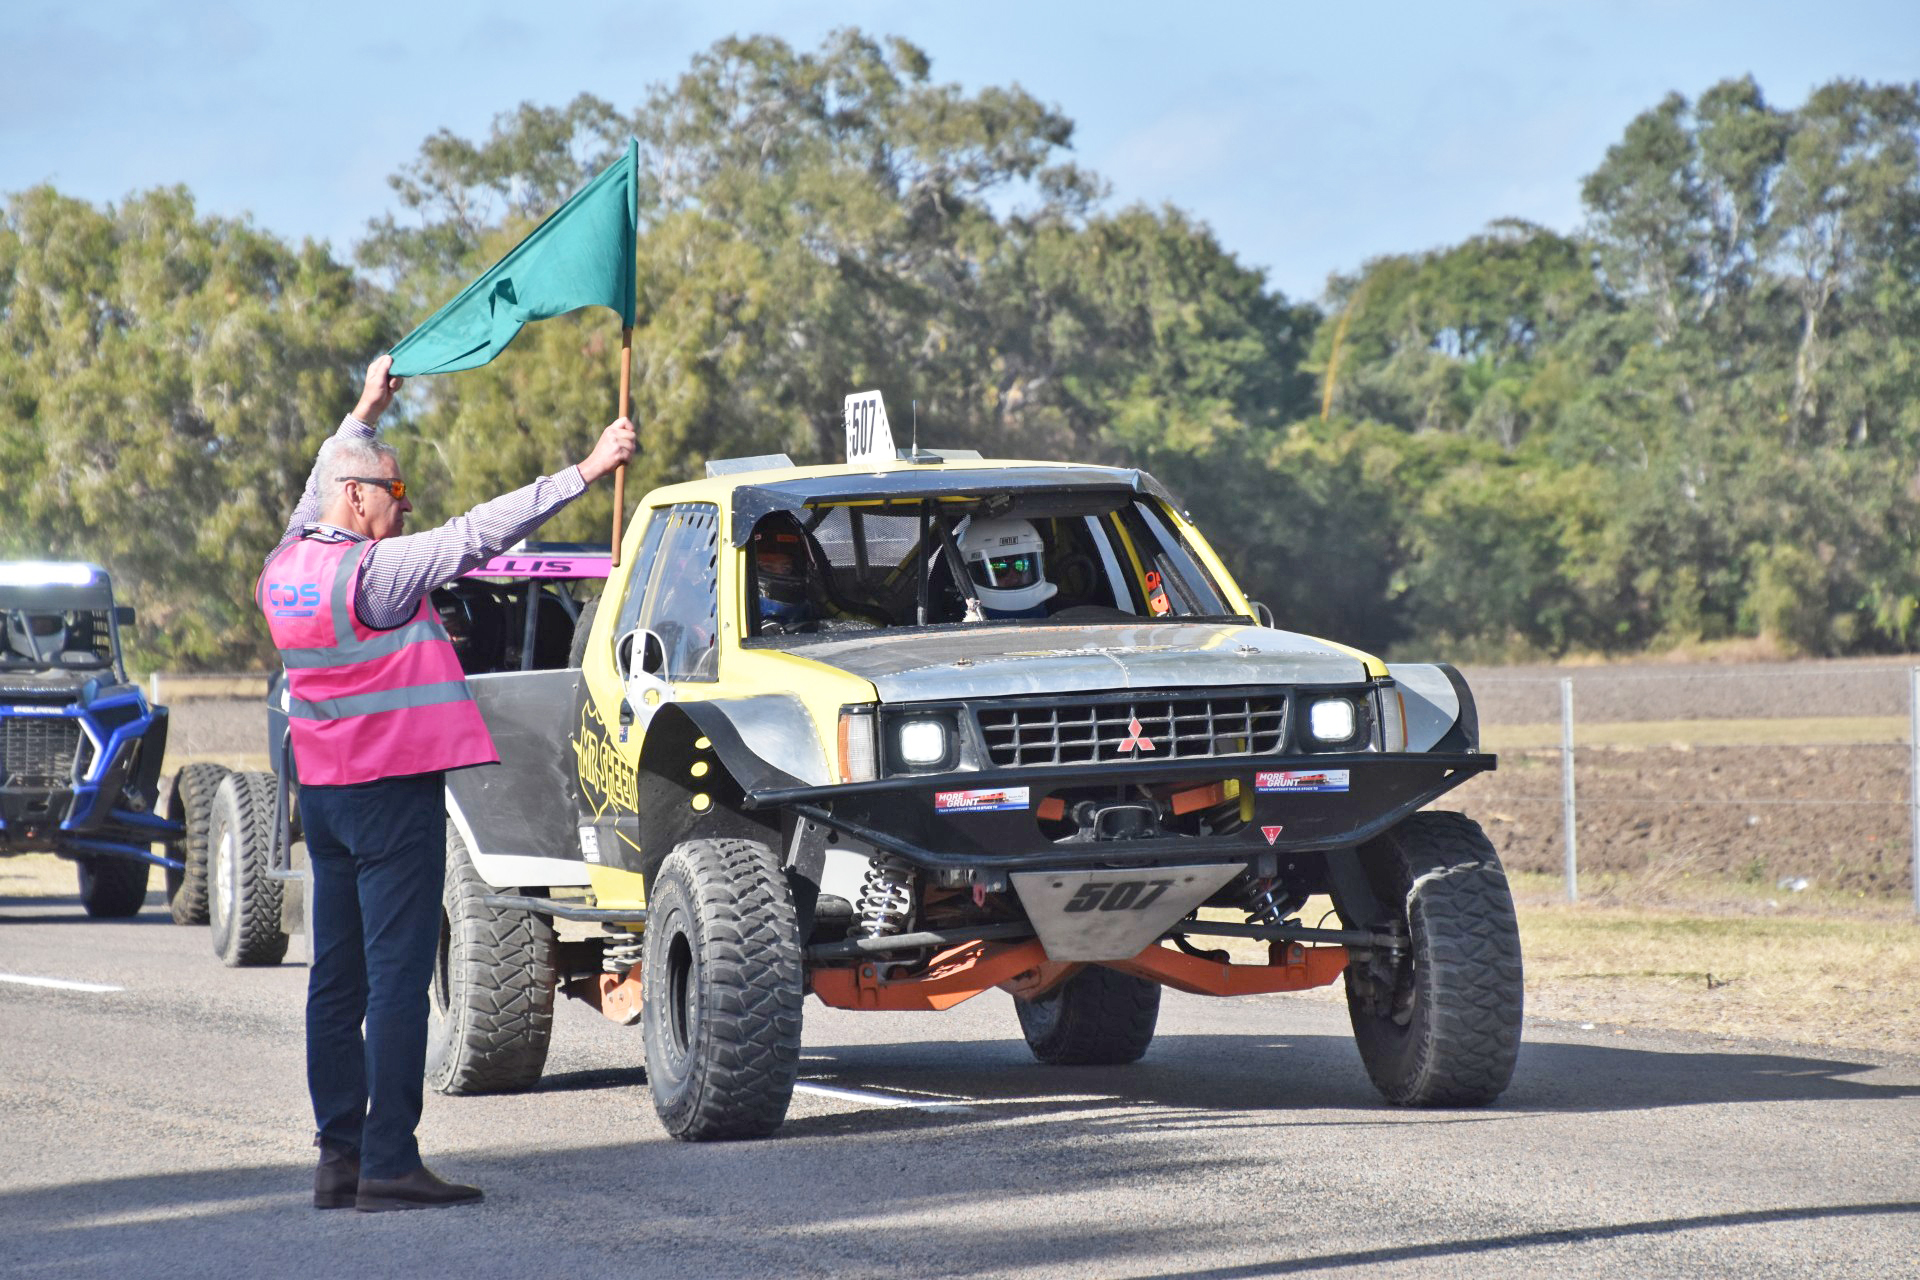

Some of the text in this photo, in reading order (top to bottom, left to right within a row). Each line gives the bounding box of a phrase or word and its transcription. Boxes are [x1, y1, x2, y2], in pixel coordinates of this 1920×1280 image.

[852, 399, 876, 456] 507
[476, 560, 573, 572] LLIS
[269, 583, 320, 606] CDS
[1259, 773, 1285, 781] MORE
[1267, 778, 1301, 787] GRUNT
[939, 792, 965, 802] MORE
[946, 798, 980, 807] GRUNT
[1064, 878, 1176, 912] 507
